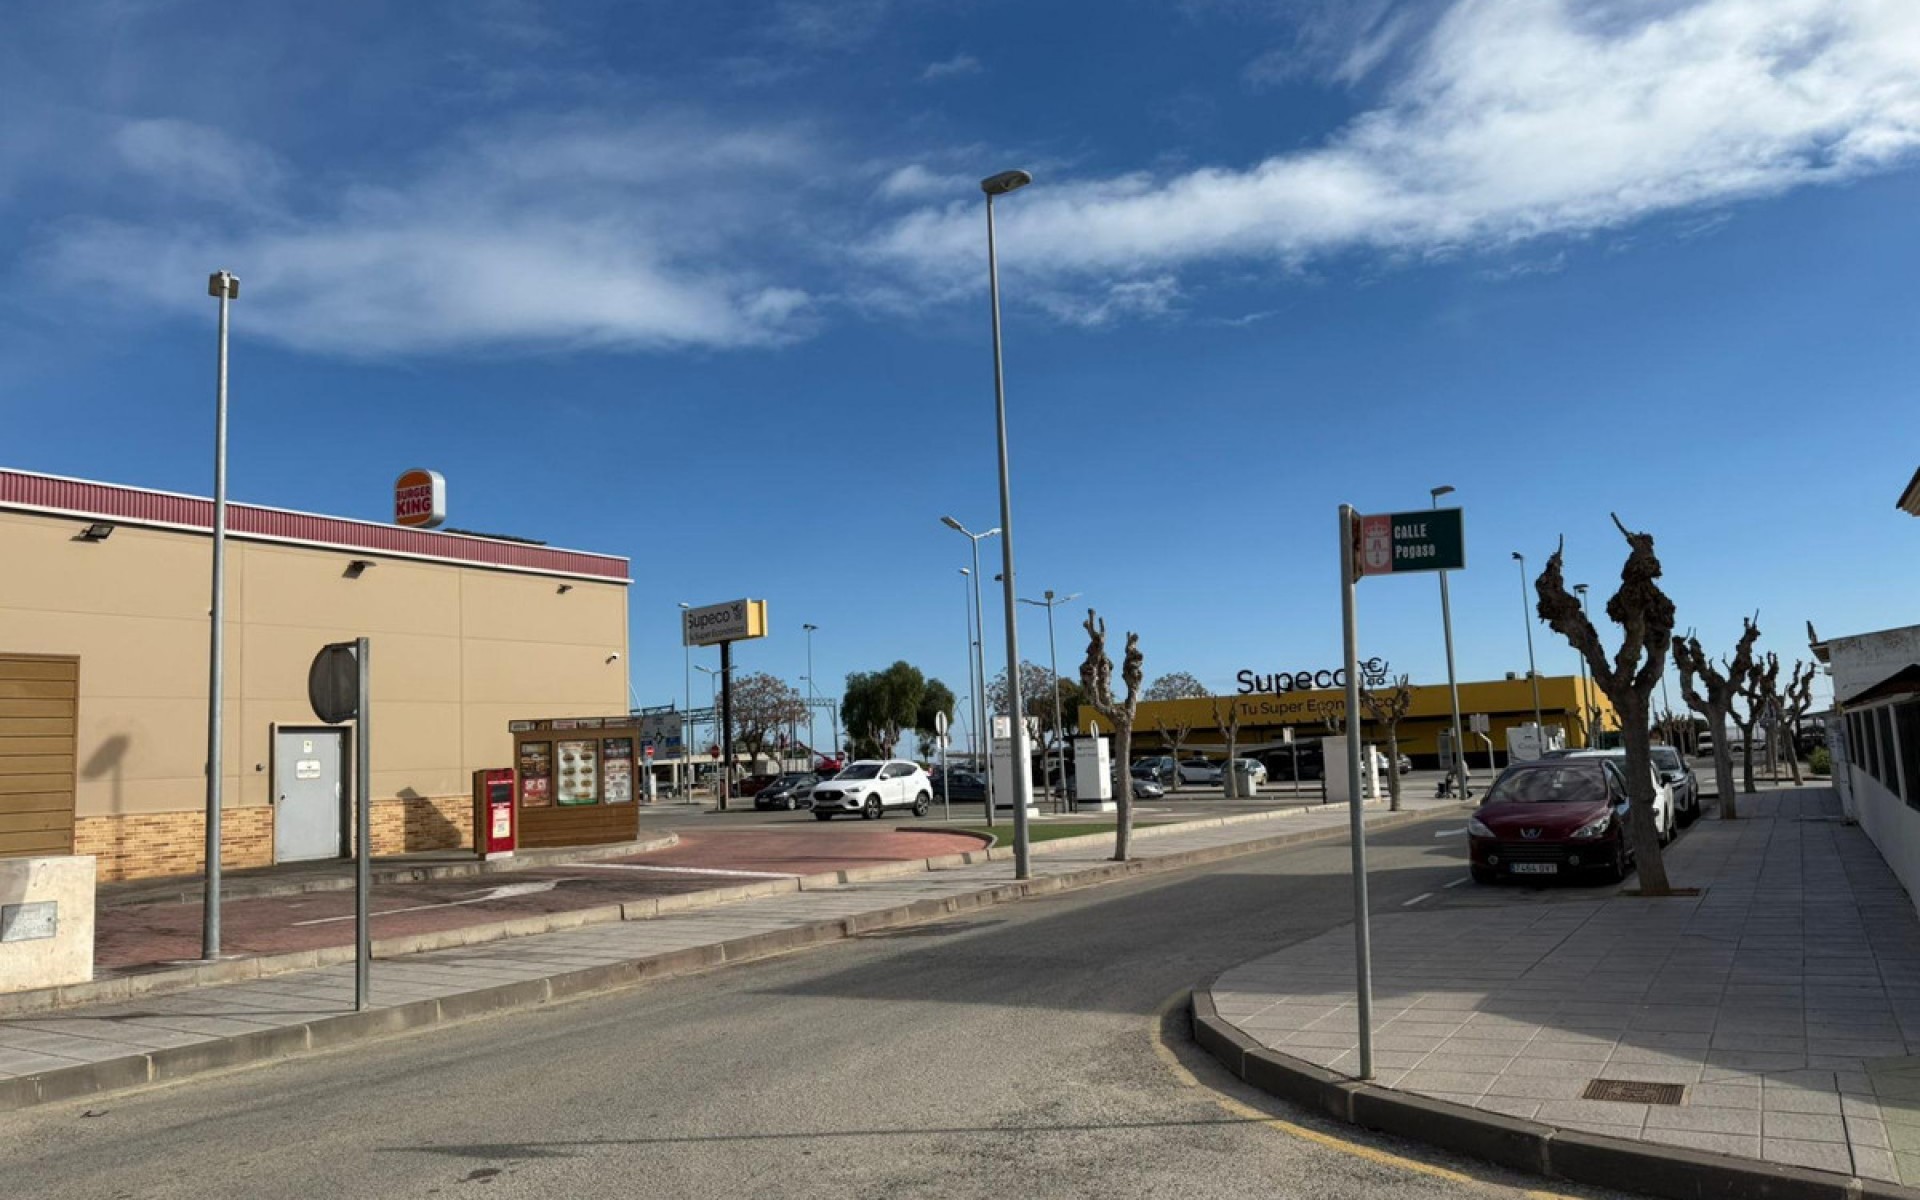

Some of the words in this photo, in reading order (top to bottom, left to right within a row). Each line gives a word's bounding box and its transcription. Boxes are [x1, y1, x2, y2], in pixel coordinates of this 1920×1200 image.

[397, 486, 431, 500] BURGER
[397, 497, 431, 516] KING
[1394, 524, 1427, 539] CALLE
[1395, 544, 1436, 559] Pegaso
[688, 610, 730, 629] Supeco
[1241, 703, 1257, 715] Tu
[1260, 701, 1303, 717] Super
